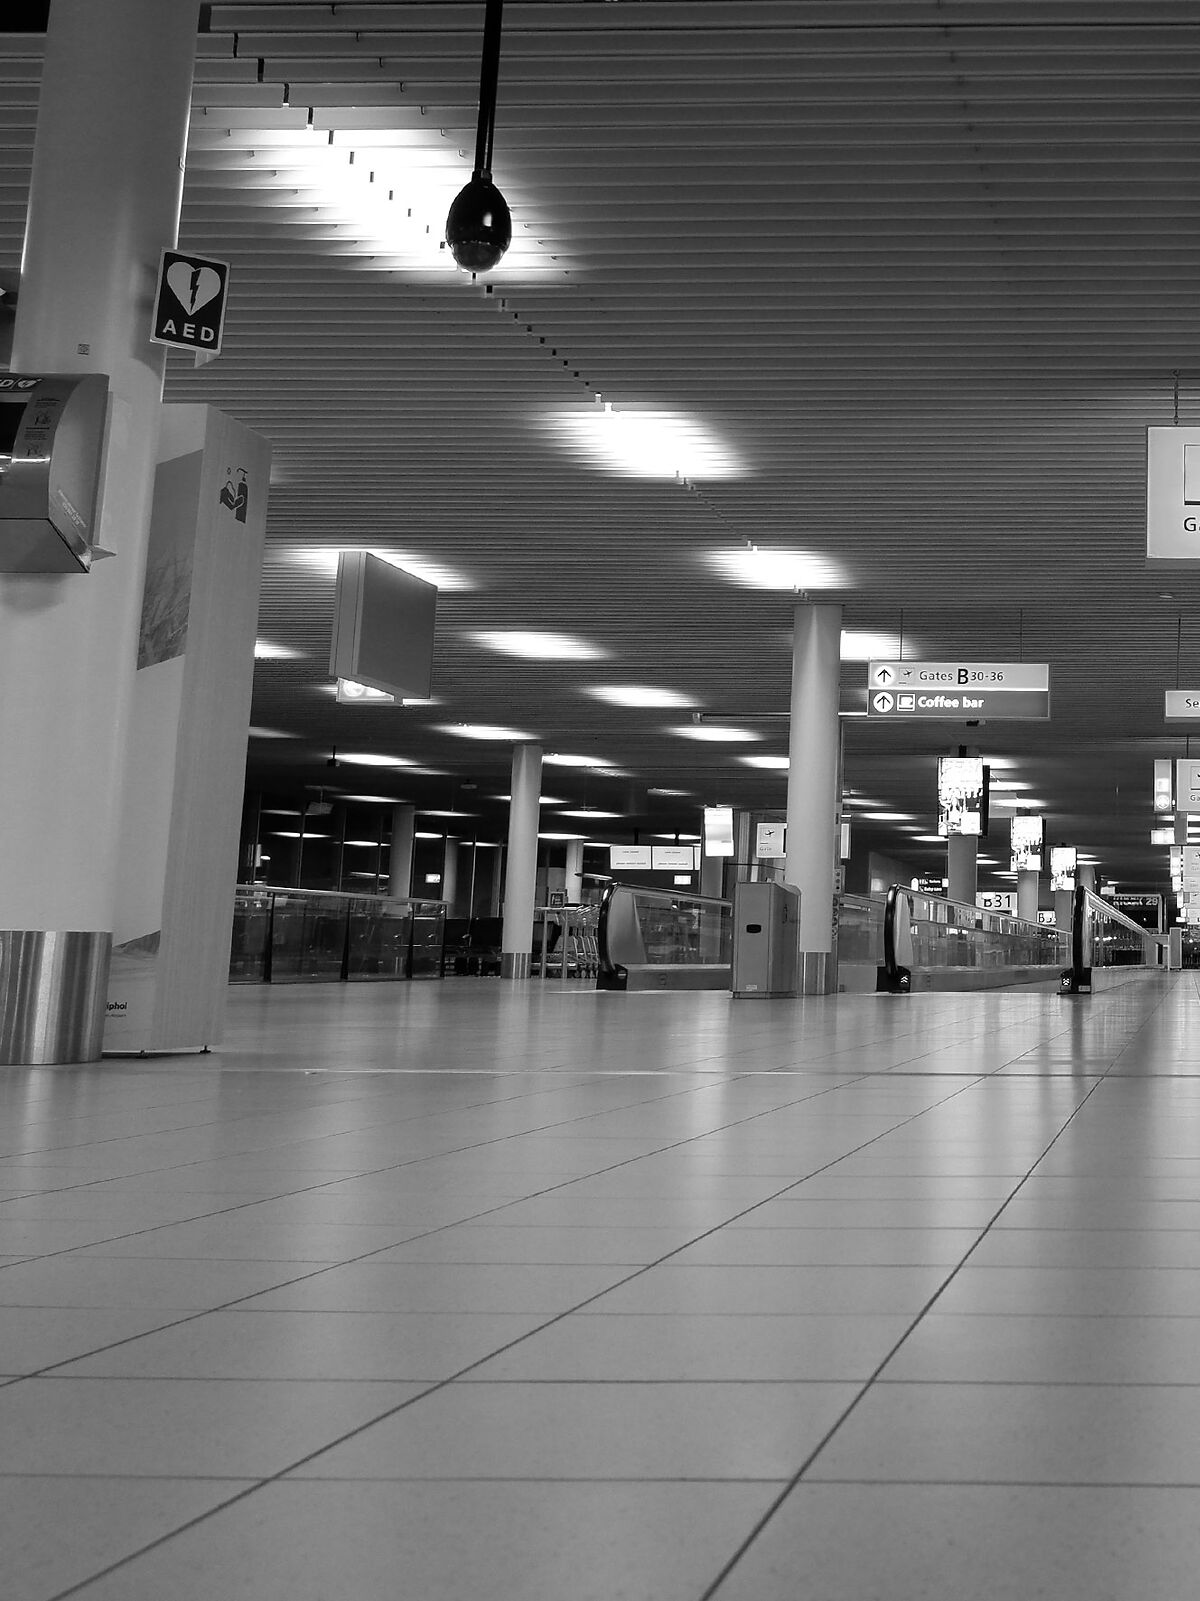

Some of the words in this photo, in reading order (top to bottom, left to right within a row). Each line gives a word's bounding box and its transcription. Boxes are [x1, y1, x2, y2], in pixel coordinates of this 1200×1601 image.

[162, 319, 215, 342] AED
[919, 670, 953, 681] Gates
[917, 695, 960, 709] Coffee
[962, 695, 985, 709] bar
[983, 894, 1011, 908] B31
[106, 1001, 128, 1011] iphol
